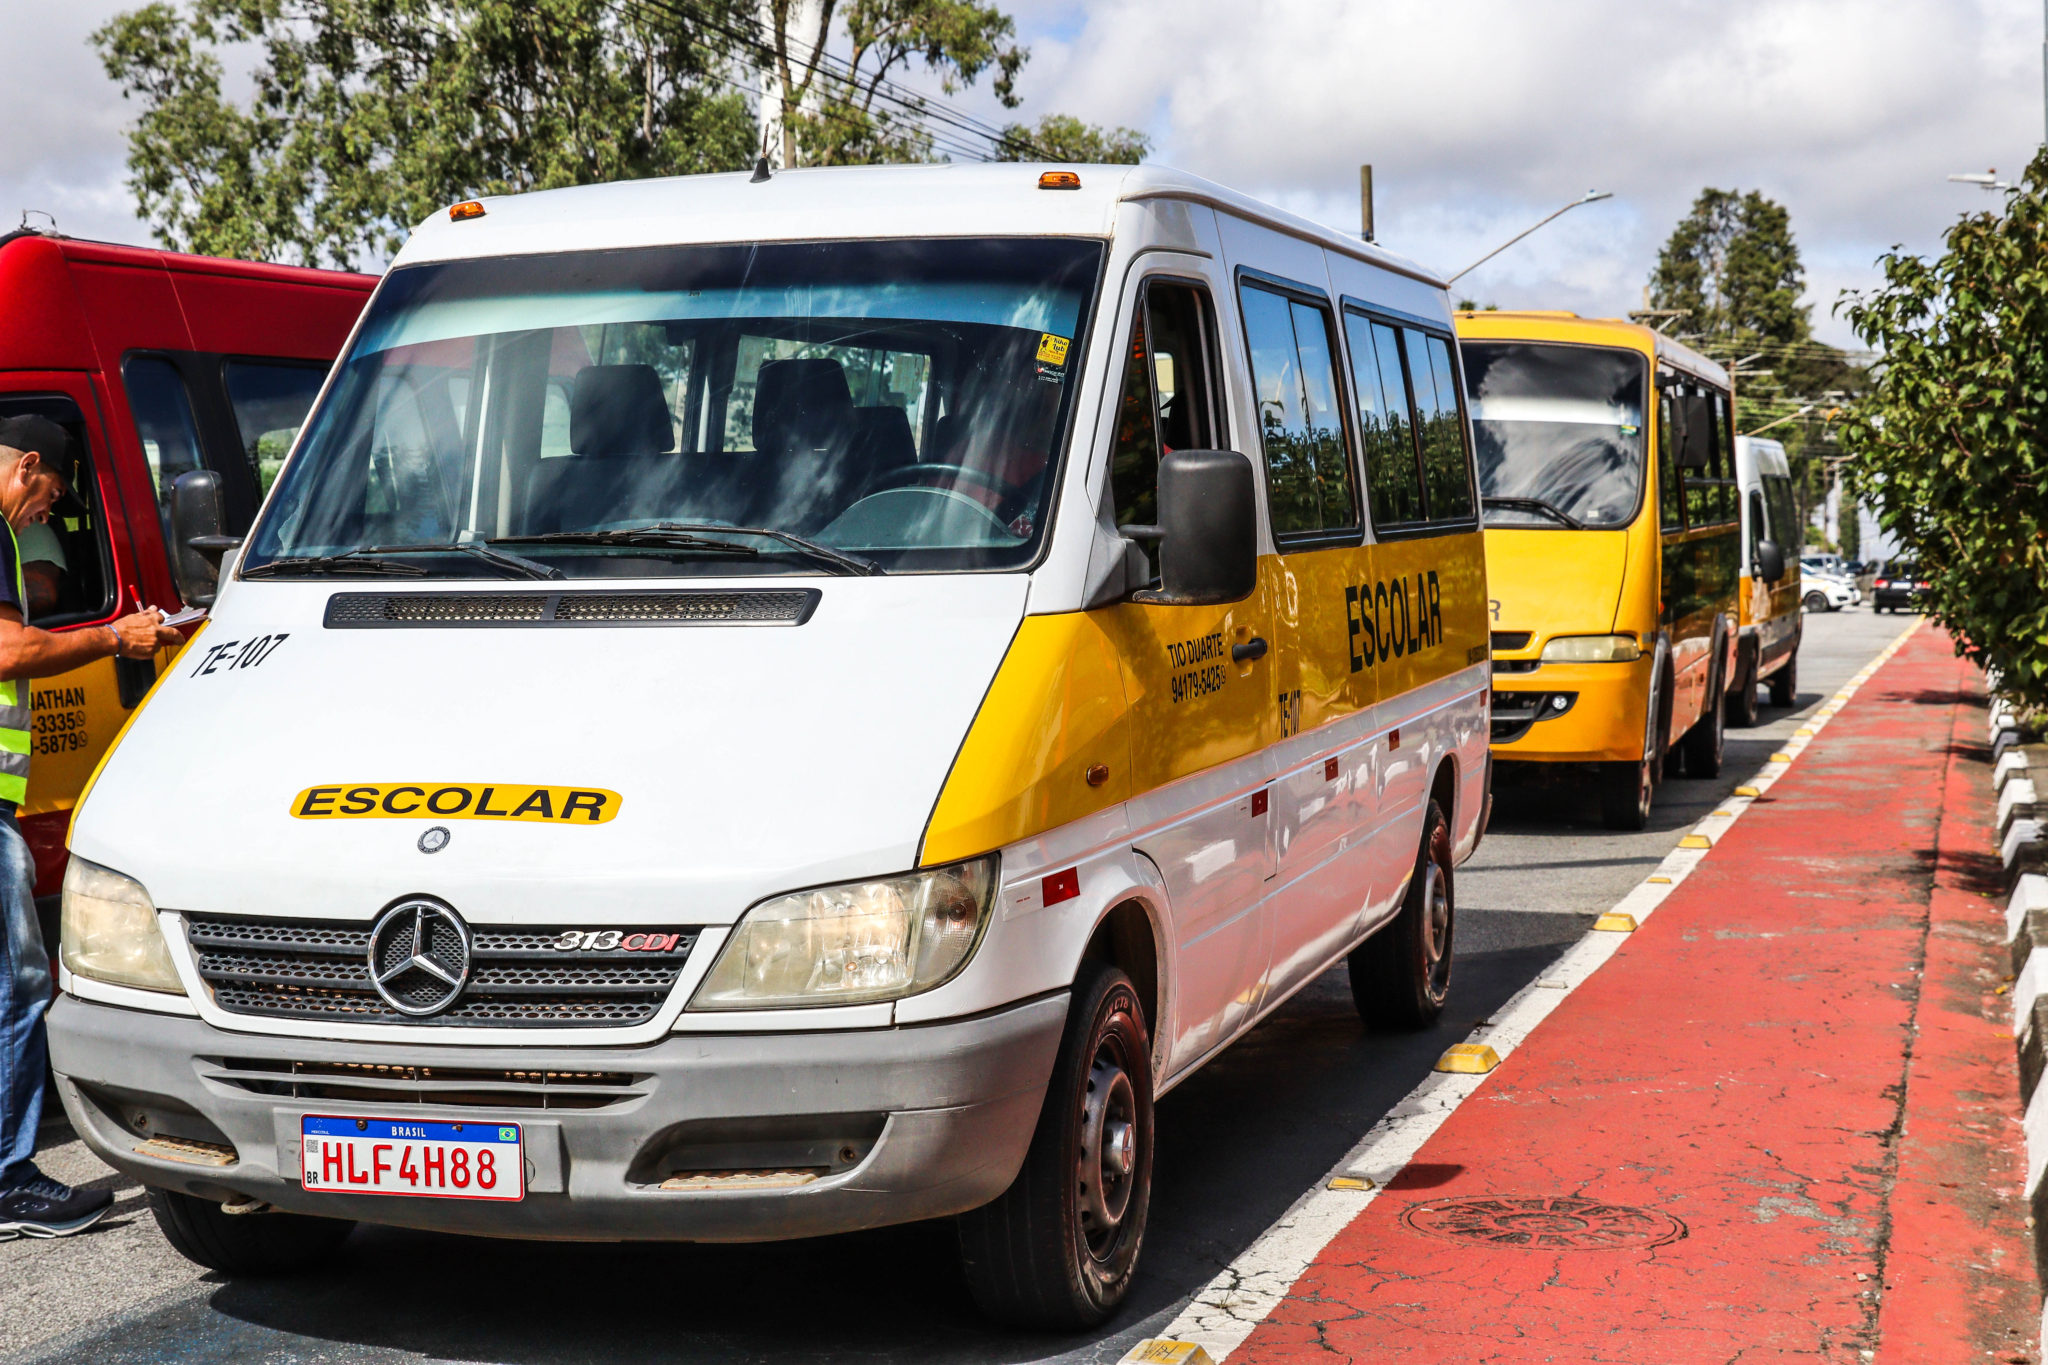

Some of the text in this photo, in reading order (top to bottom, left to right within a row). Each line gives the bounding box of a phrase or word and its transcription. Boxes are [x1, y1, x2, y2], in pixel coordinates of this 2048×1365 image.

[1345, 570, 1442, 673] ESCOLAR
[190, 633, 290, 678] TE-107
[1167, 633, 1223, 669] TIO DUARTE
[1171, 665, 1221, 703] 94179-5425
[31, 732, 78, 756] -5879
[299, 786, 607, 821] ESCOLAR
[391, 1126, 426, 1137] BRASIL
[306, 1171, 318, 1184] BR
[322, 1141, 497, 1189] HLF4H88
